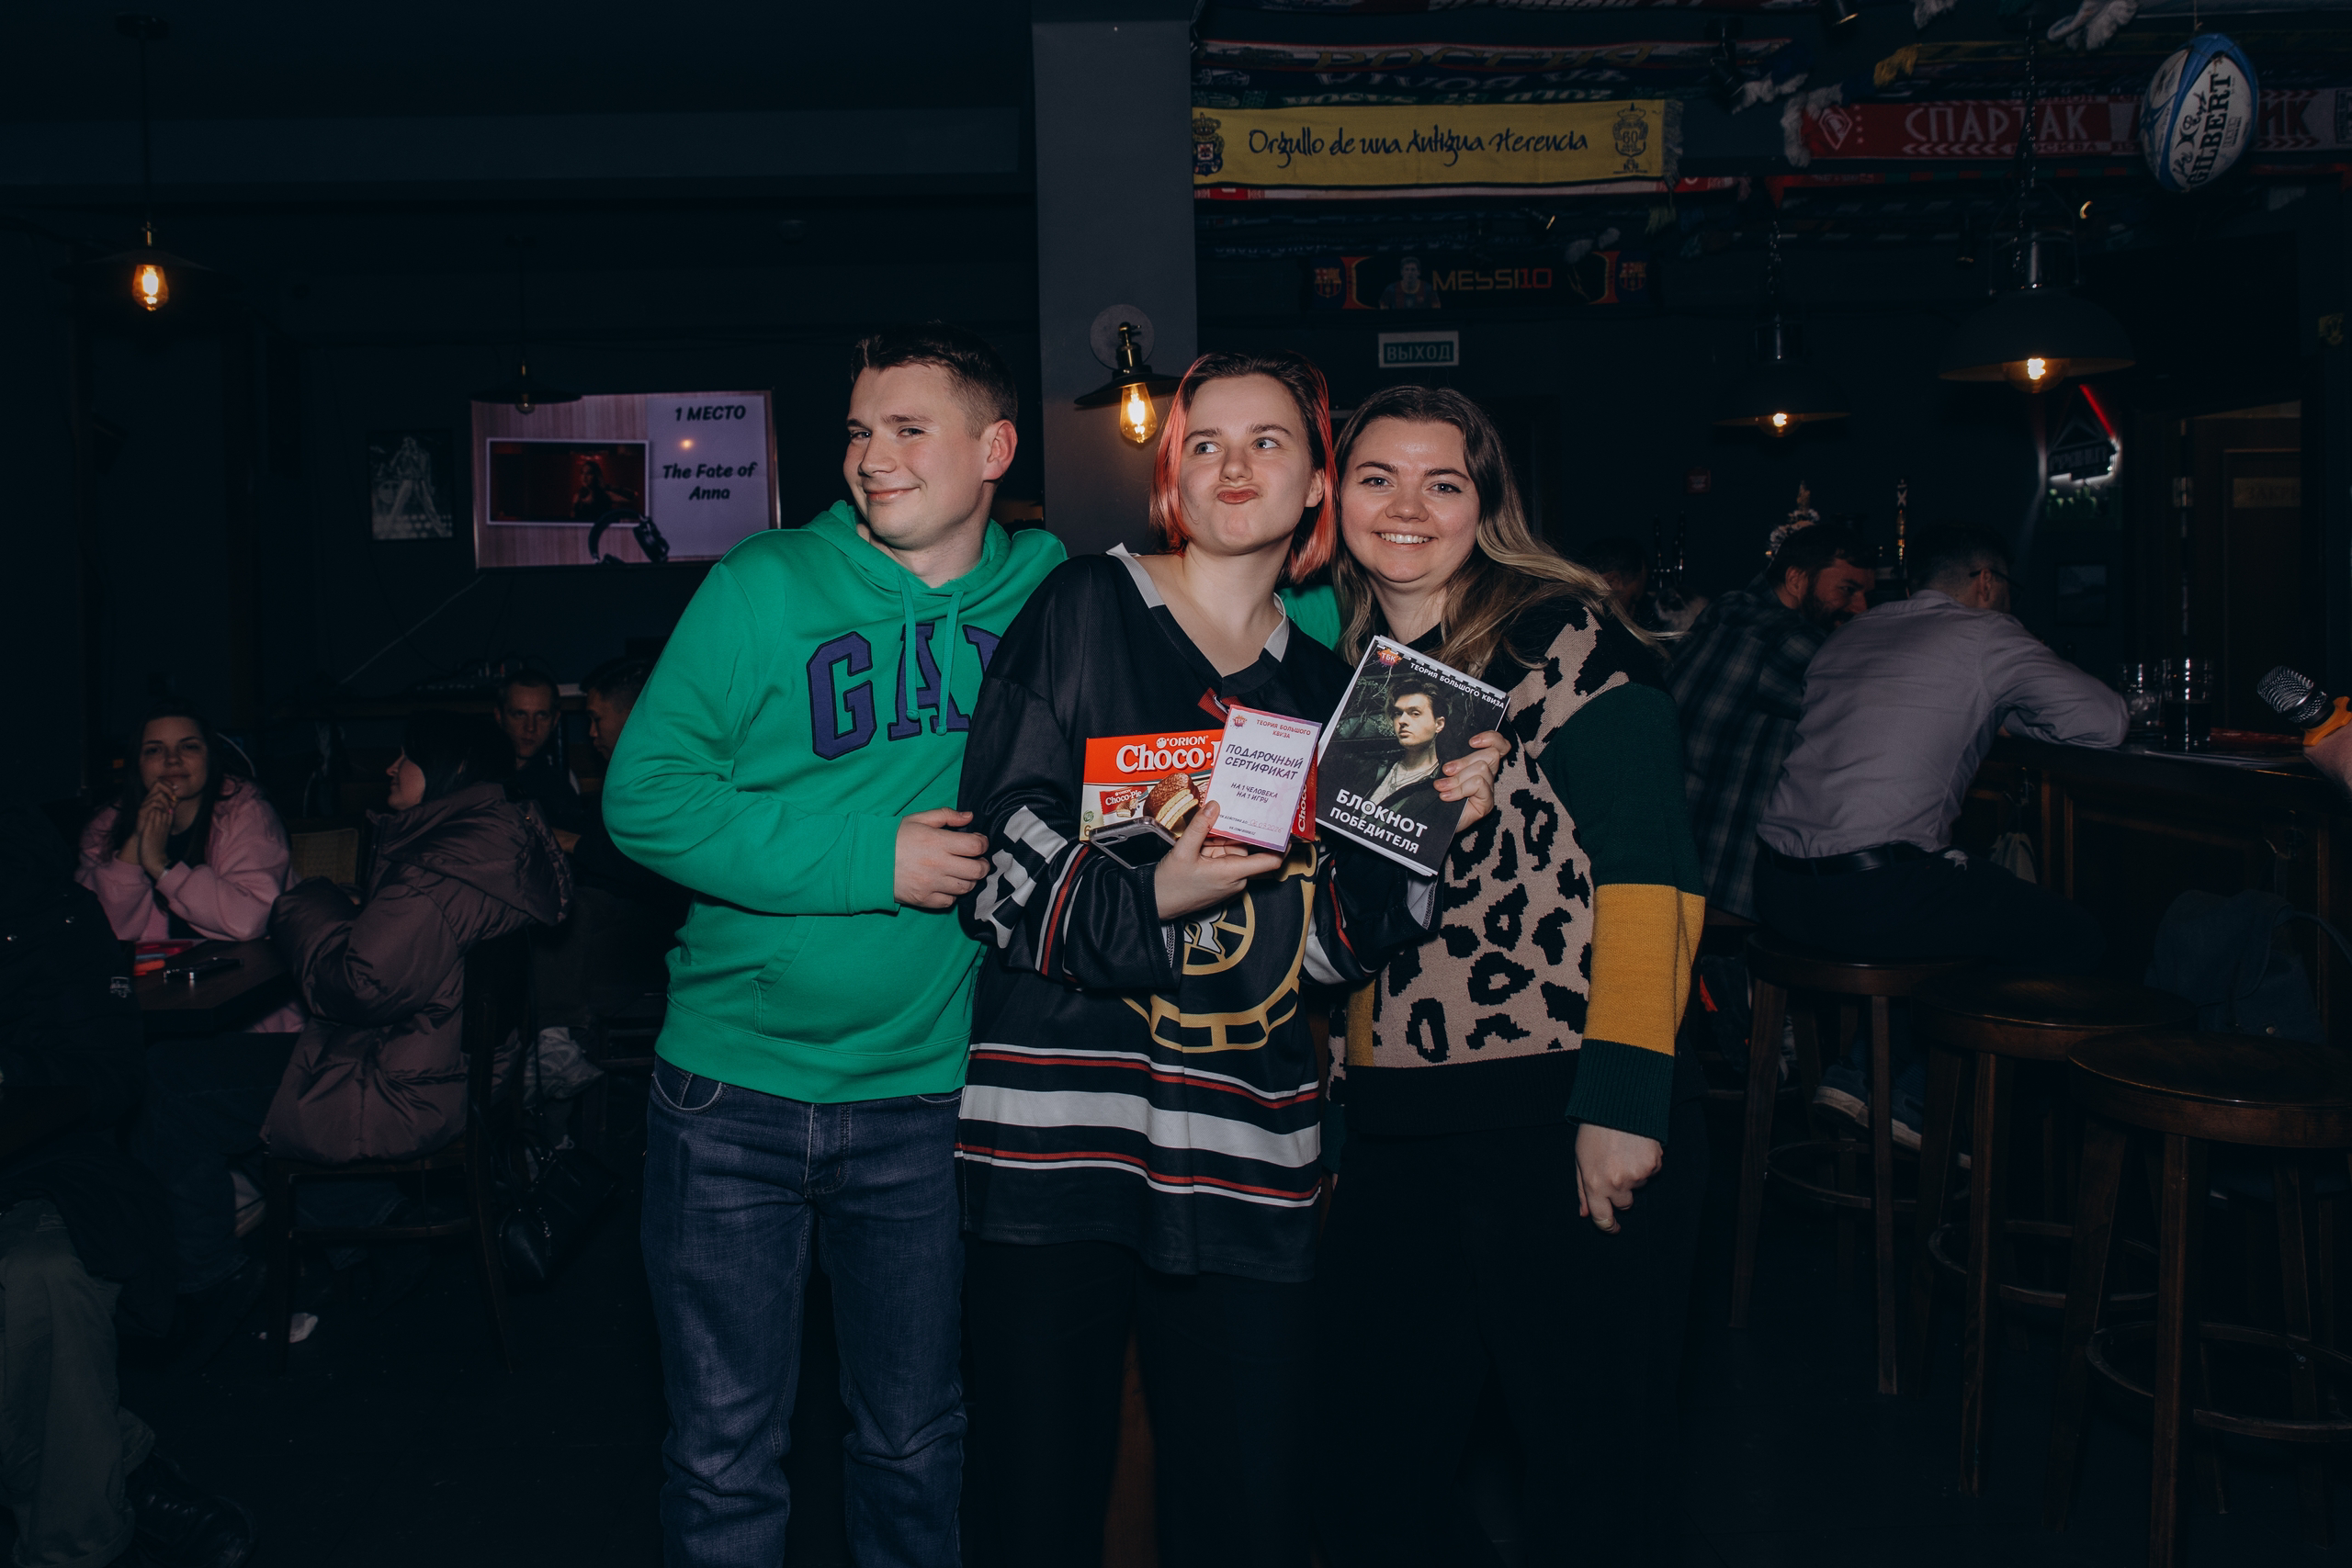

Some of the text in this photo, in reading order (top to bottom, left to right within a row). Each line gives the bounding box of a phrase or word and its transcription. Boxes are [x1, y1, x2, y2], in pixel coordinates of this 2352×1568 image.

[1904, 103, 2087, 142] СПАРТАК
[2187, 73, 2232, 185] GILBERT
[1249, 124, 1589, 168] Orgullo de una Antigua Herencia
[1623, 130, 1638, 144] 60
[1386, 344, 1452, 362] ВЫХОД
[675, 405, 746, 422] 1 МЕСТО
[662, 461, 758, 479] The Fate of
[688, 486, 731, 501] Anna
[1381, 652, 1396, 662] ТБК
[1410, 662, 1505, 709] ТЕОРИЯ БОЛЬШОГО КВИЗА
[1256, 719, 1311, 736] ТЕОРИЯ БОЛЬШОГО
[1272, 730, 1291, 739] КВИЗА
[1169, 736, 1206, 747] ORION
[1226, 744, 1304, 768] ПОДАРОЧНЫЙ
[1225, 756, 1298, 780] СЕРТИФИКАТ
[1230, 782, 1240, 790] НА
[1246, 785, 1278, 798] ЧЕЛОВЕКА
[1236, 791, 1246, 799] НА
[1251, 795, 1269, 803] ИГРУ
[1336, 788, 1428, 838] БЛОКНОТ
[1329, 807, 1419, 854] ПОБЕДИТЕЛЯ
